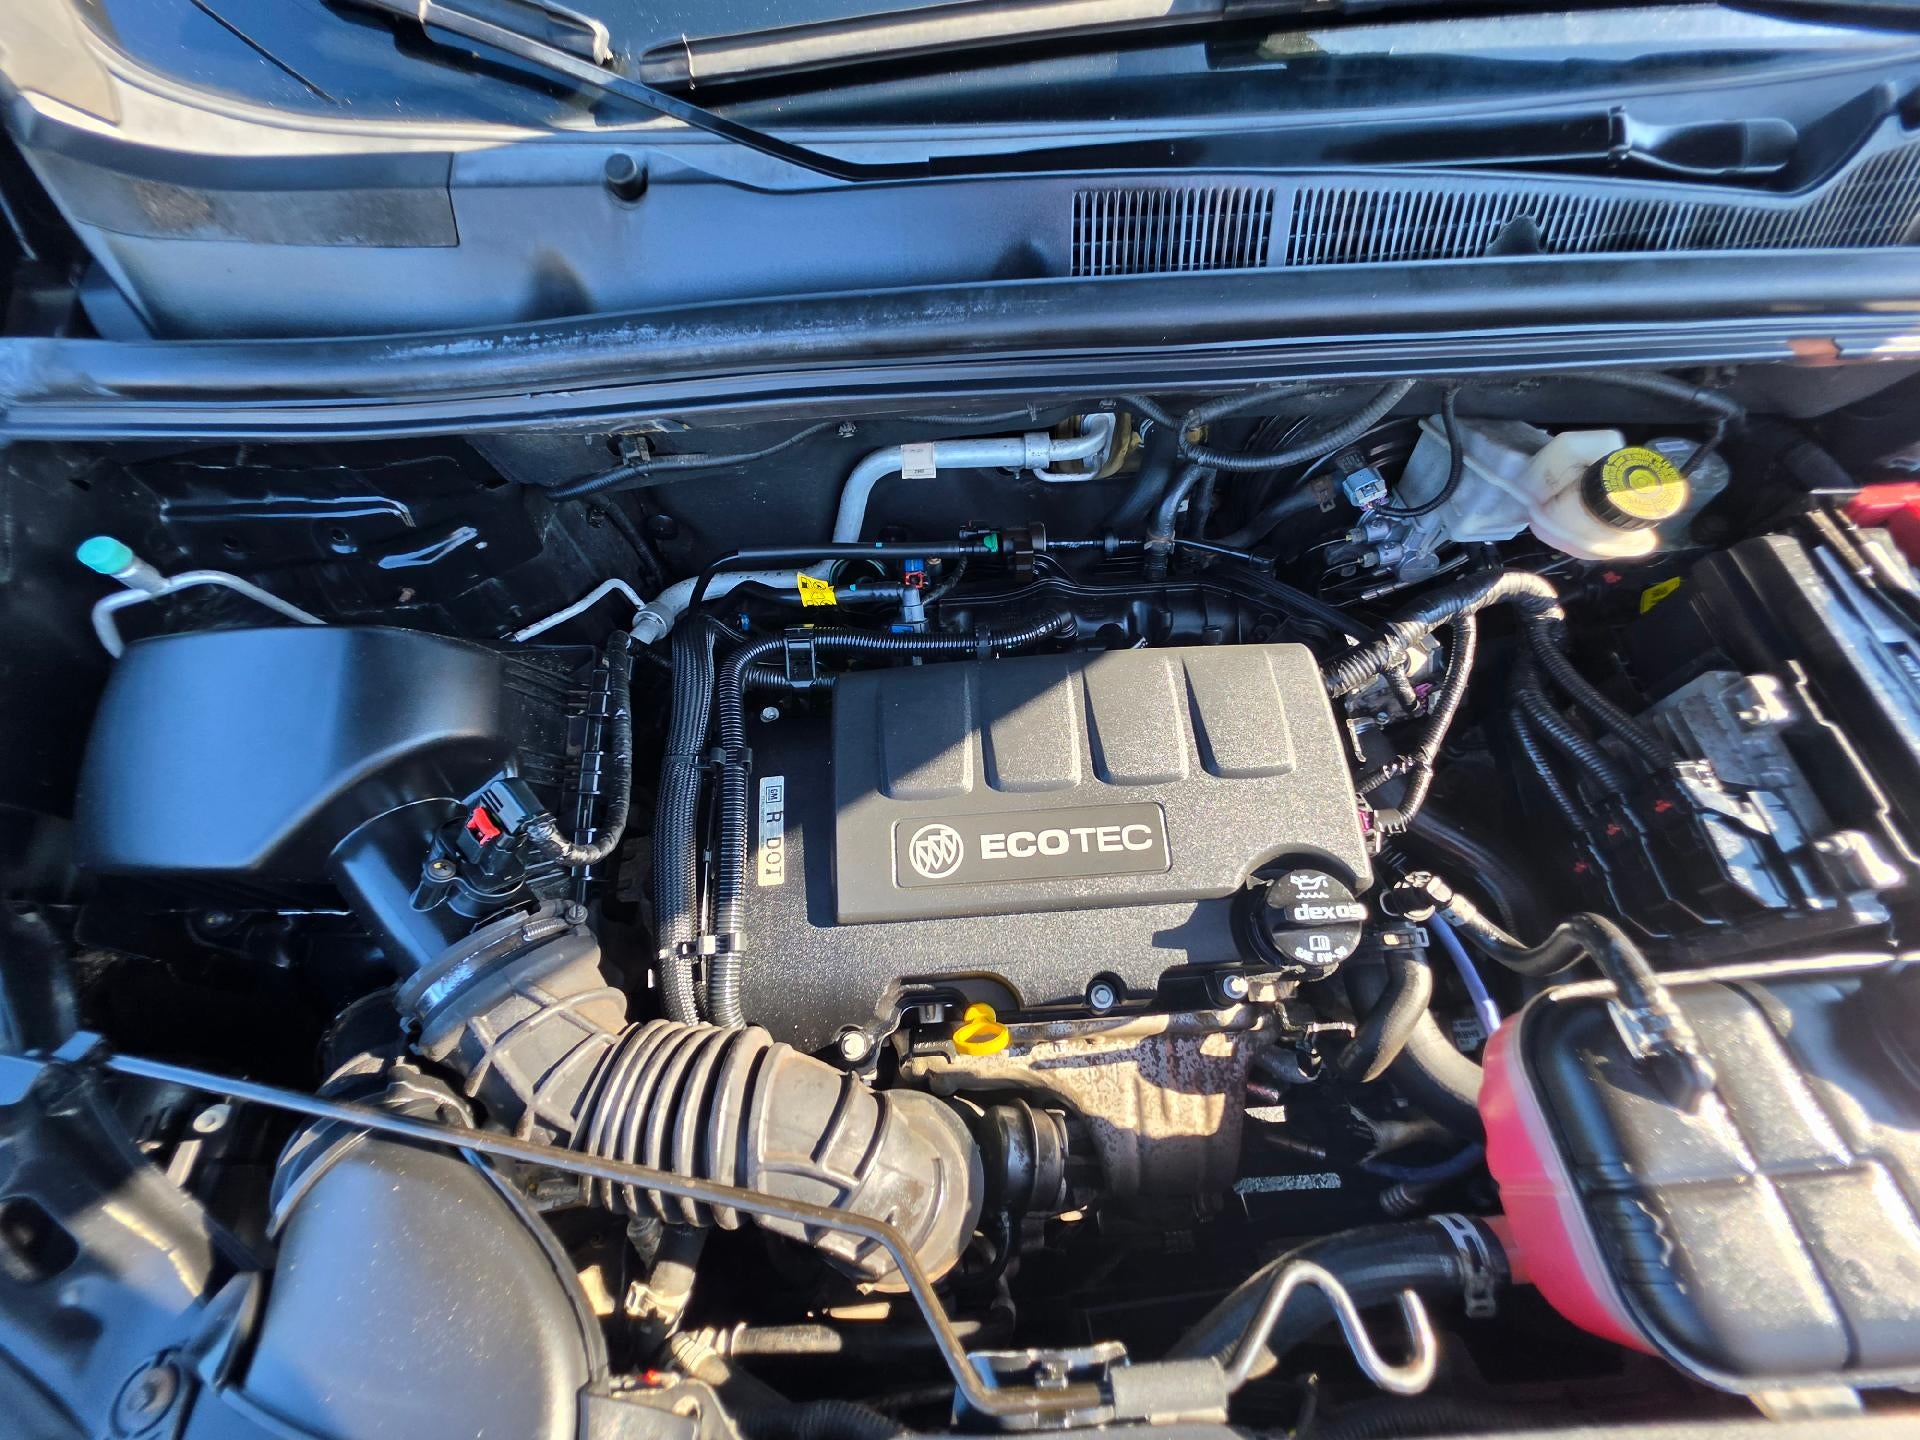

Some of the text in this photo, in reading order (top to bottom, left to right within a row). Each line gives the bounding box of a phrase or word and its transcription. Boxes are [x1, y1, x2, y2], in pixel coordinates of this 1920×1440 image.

[766, 810, 783, 824] R
[980, 824, 1153, 860] ECOTEC
[1294, 903, 1367, 921] dexos
